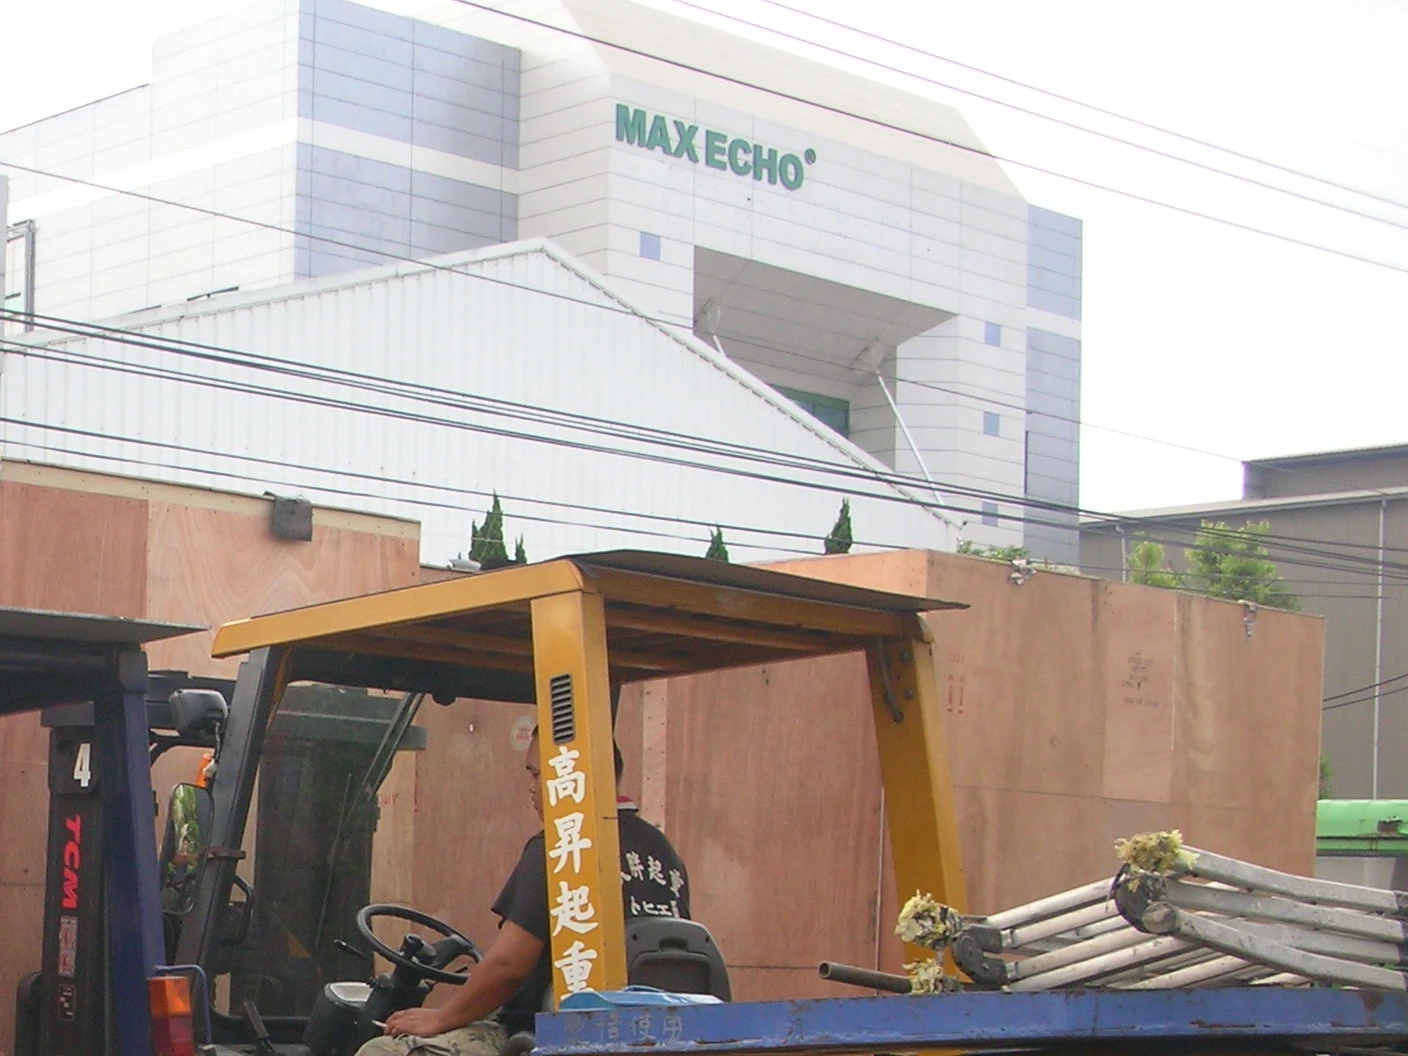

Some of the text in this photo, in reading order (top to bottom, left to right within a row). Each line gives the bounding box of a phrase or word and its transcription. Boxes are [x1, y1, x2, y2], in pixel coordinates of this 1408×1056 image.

[615, 103, 805, 192] MAX ECHO
[73, 742, 92, 788] 4
[61, 814, 83, 909] TCM
[546, 746, 599, 1000] 高昇起重
[620, 851, 685, 898] 胖起重
